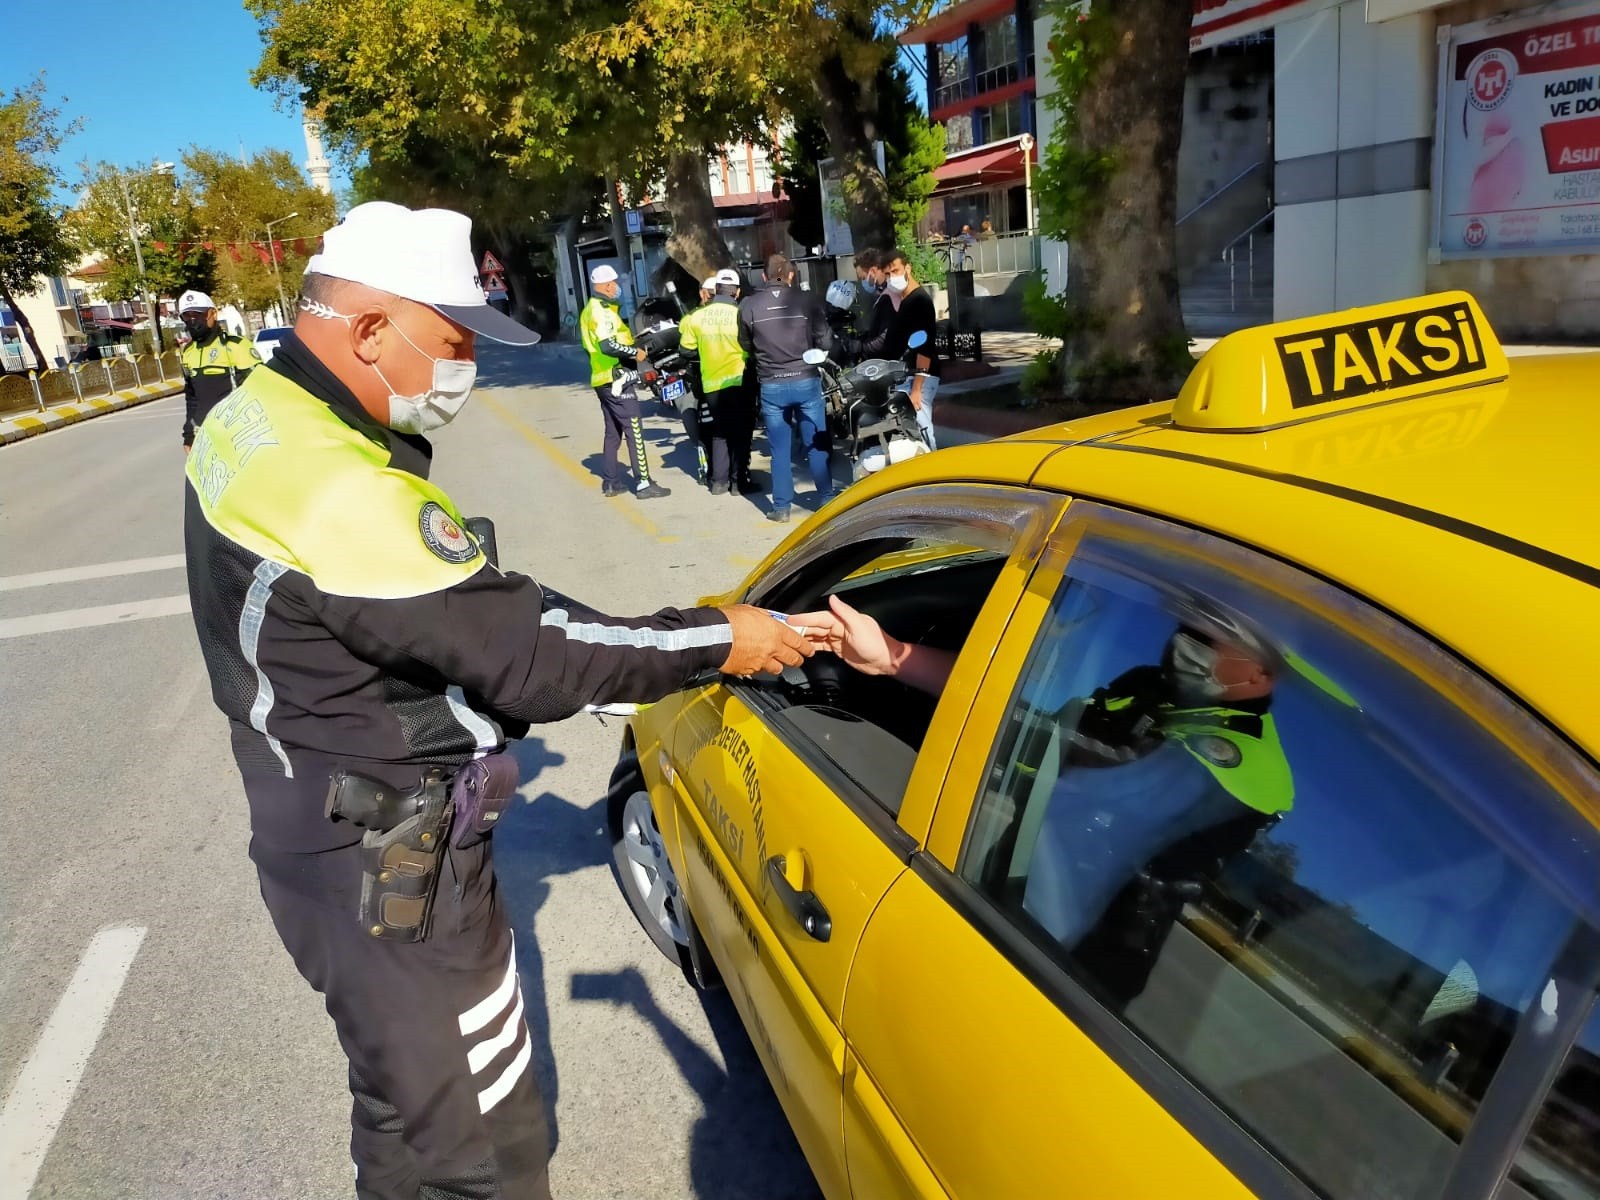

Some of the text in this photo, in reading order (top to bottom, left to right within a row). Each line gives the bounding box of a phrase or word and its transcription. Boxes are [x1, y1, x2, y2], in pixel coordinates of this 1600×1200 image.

[1524, 31, 1576, 57] ÖZEL
[1544, 77, 1593, 99] KADIN
[1551, 100, 1570, 118] VE
[718, 725, 751, 769] DEVLET
